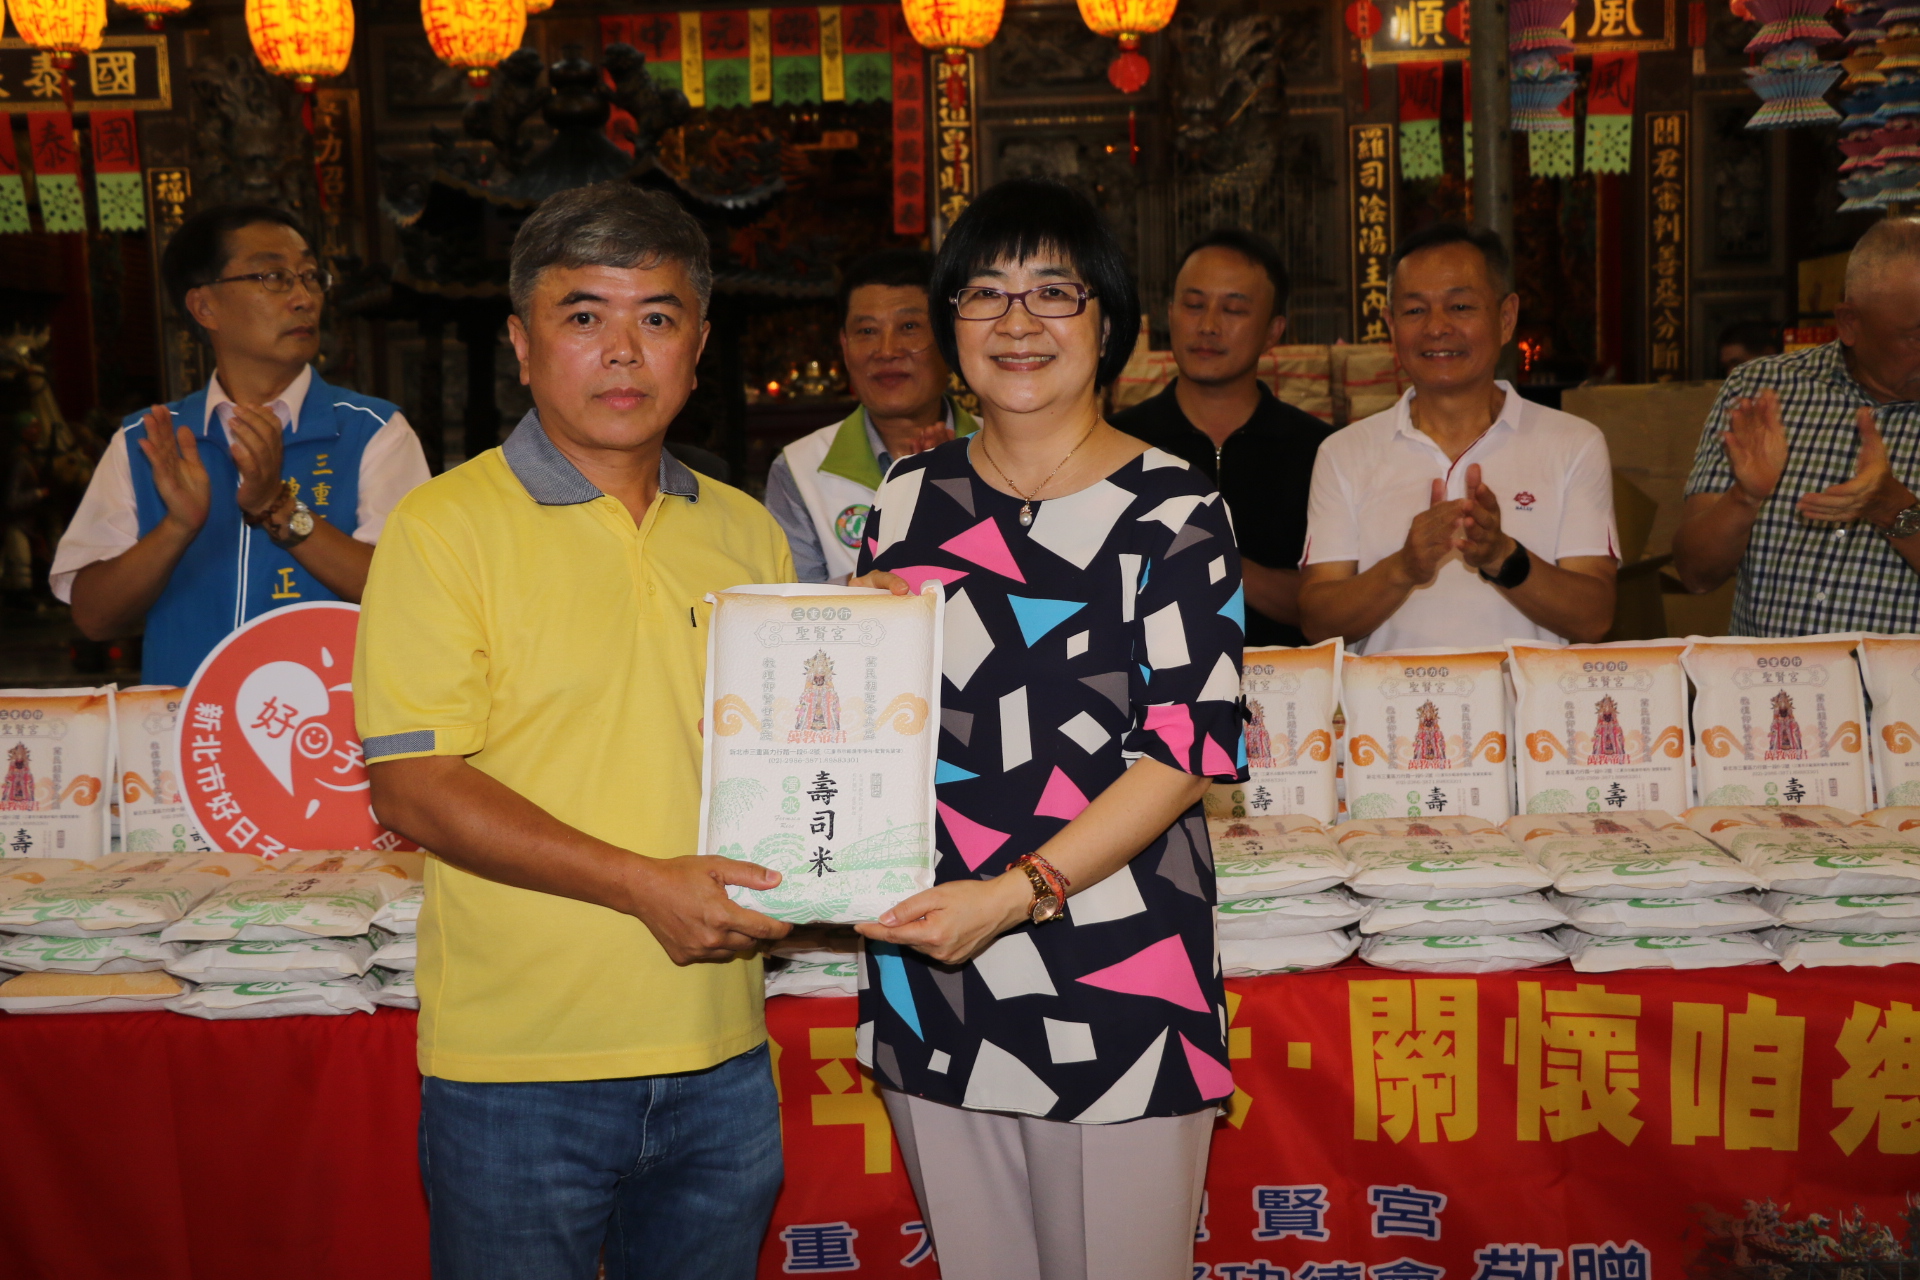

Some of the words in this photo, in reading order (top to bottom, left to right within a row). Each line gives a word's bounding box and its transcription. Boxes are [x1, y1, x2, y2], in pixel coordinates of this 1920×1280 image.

[312, 453, 333, 519] 三重
[271, 567, 302, 600] 正
[791, 607, 851, 621] 三重力行
[796, 626, 846, 641] 聖賢宮
[250, 696, 300, 739] 好
[1250, 785, 1273, 811] 壽
[1425, 786, 1448, 812] 壽
[1605, 782, 1627, 808] 壽
[1783, 777, 1806, 803] 壽
[807, 770, 838, 877] 壽司米
[10, 828, 33, 853] 壽
